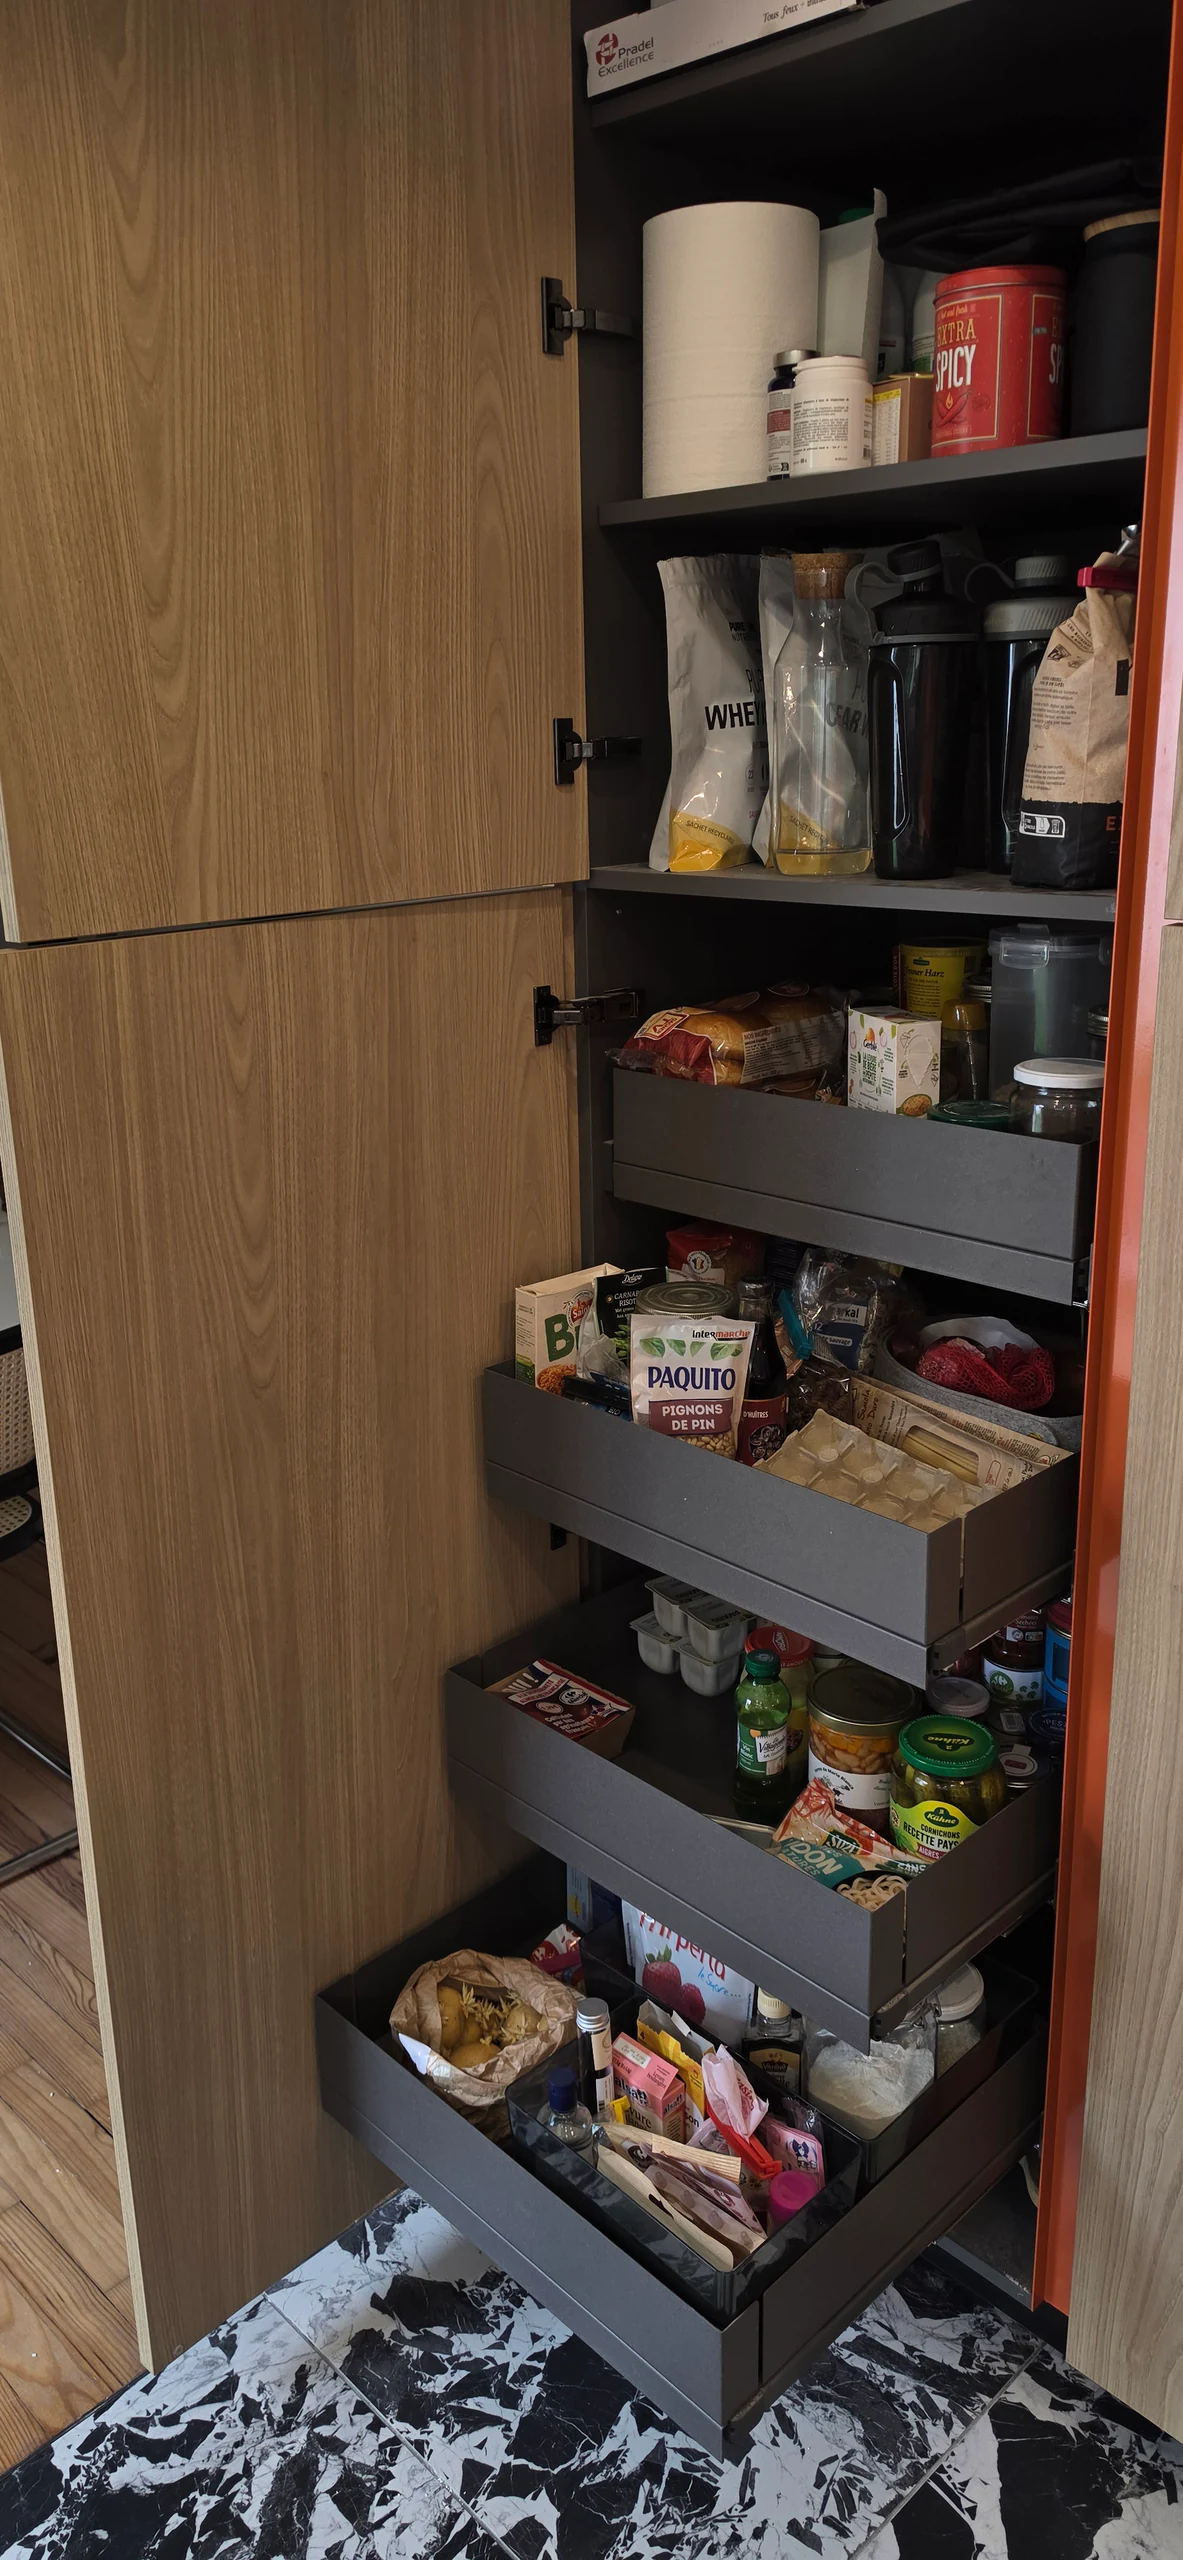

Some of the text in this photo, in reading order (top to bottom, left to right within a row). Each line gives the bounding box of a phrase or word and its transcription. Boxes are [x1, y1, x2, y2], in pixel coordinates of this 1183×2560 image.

[763, 12, 779, 23] Tous
[618, 37, 654, 58] Pradel
[598, 51, 654, 77] Excellence
[937, 318, 976, 347] EXTRA
[936, 344, 976, 392] SPICY
[686, 820, 708, 834] SACHET
[925, 968, 945, 978] Harz
[648, 1366, 736, 1391] PAQUITO
[662, 1404, 723, 1416] PIGNONS
[743, 1410, 769, 1419] D'HUÎTRES
[867, 1397, 879, 1420] Duro
[672, 1419, 715, 1430] DE PIN
[740, 1748, 754, 1759] Blanc
[742, 1743, 751, 1752] Vin
[927, 1813, 957, 1824] Kühne
[903, 1821, 935, 1847] RECETTE
[920, 1823, 960, 1839] CORNICHONS
[782, 1849, 820, 1876] ATURES
[615, 2076, 639, 2101] alsa
